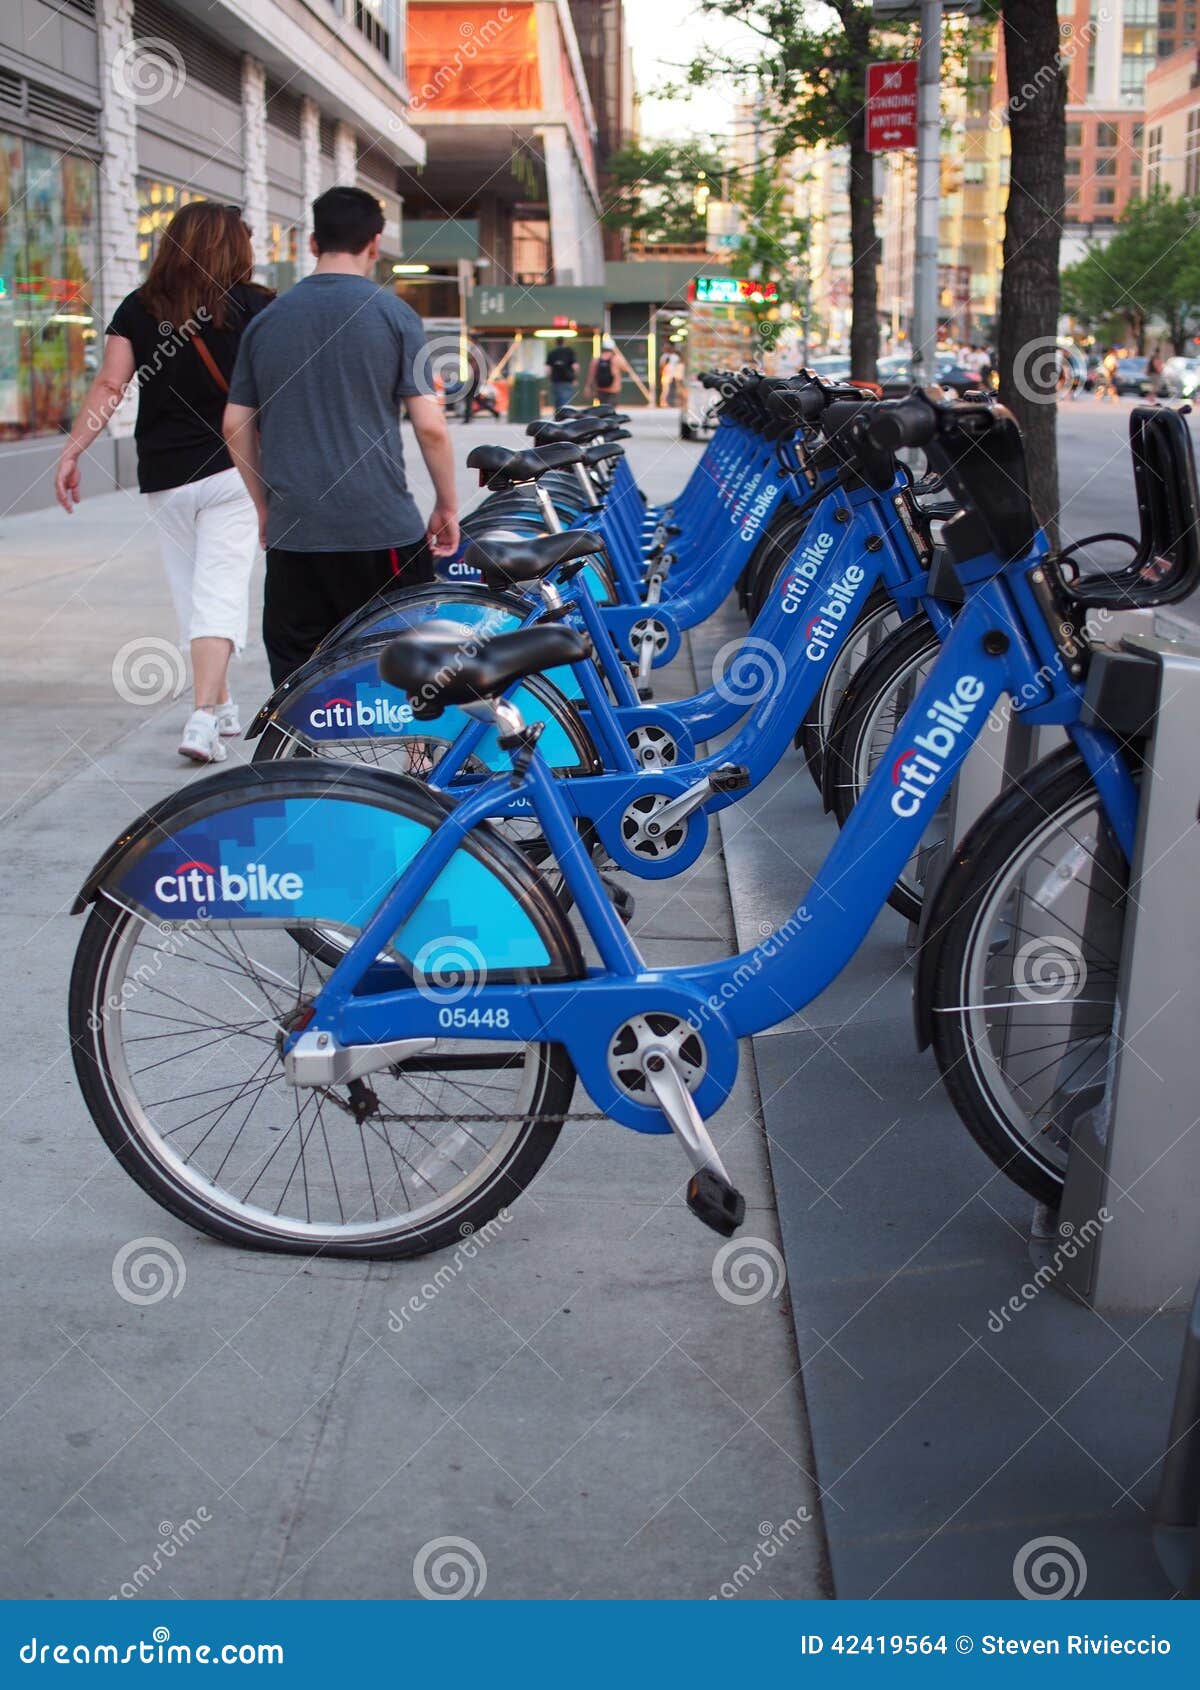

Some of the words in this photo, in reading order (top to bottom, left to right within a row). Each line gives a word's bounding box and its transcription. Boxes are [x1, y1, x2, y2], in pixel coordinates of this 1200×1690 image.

[883, 72, 902, 89] NO
[749, 484, 777, 517] bike
[794, 533, 833, 580] bike
[782, 577, 810, 614] citi
[820, 565, 864, 621] bike
[806, 618, 838, 661] citi
[309, 703, 353, 728] citi
[356, 699, 415, 726] bike
[913, 675, 985, 760] bike
[891, 754, 942, 818] citi
[154, 867, 216, 903] citi
[220, 862, 304, 902] bike
[438, 1007, 510, 1028] 05448
